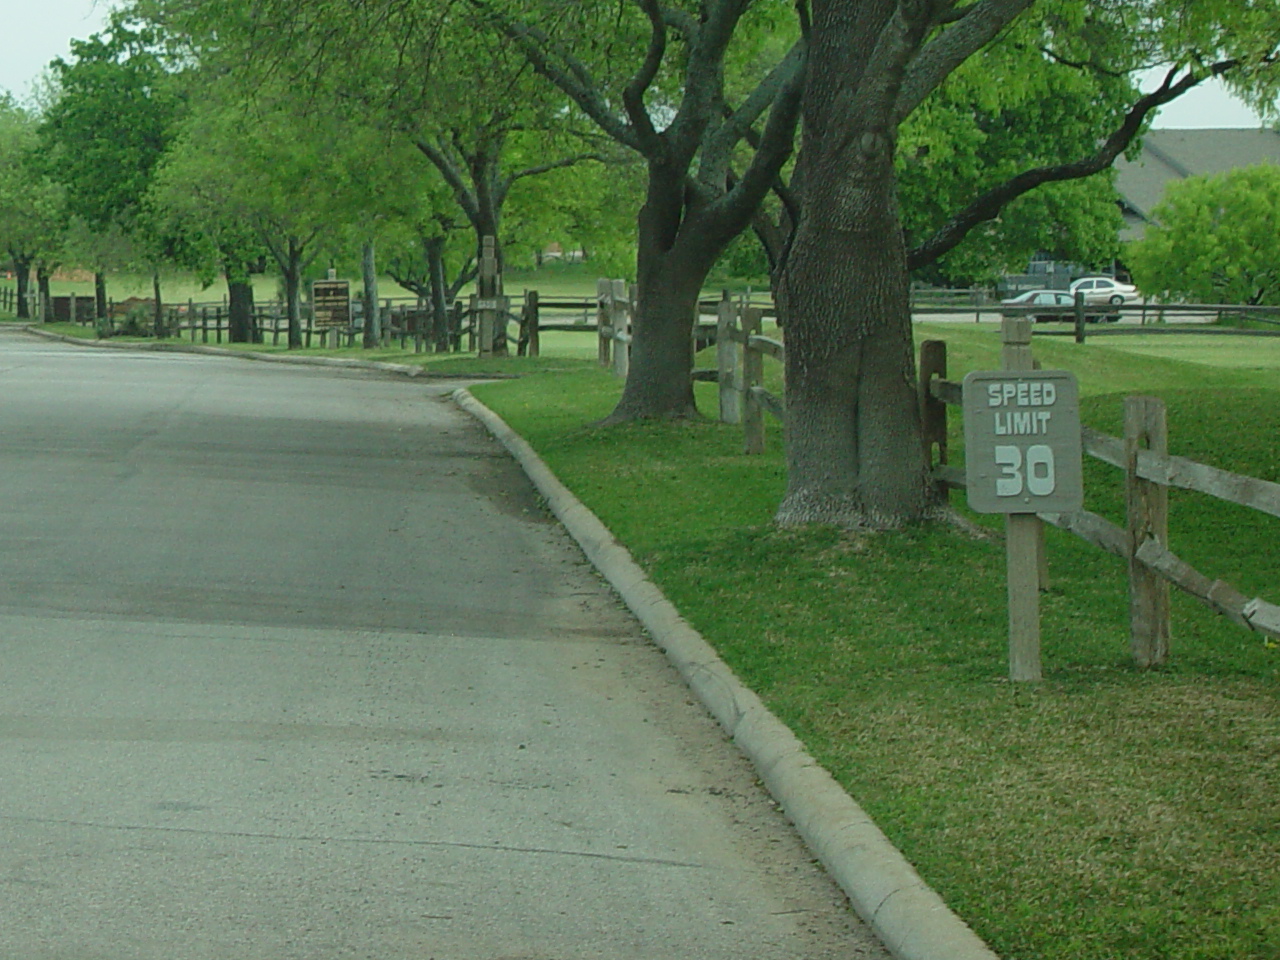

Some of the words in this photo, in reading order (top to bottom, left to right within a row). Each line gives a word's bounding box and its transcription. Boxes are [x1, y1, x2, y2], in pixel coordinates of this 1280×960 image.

[988, 383, 1056, 406] SPEED
[995, 412, 1051, 435] LIMIT
[995, 444, 1055, 497] 30
